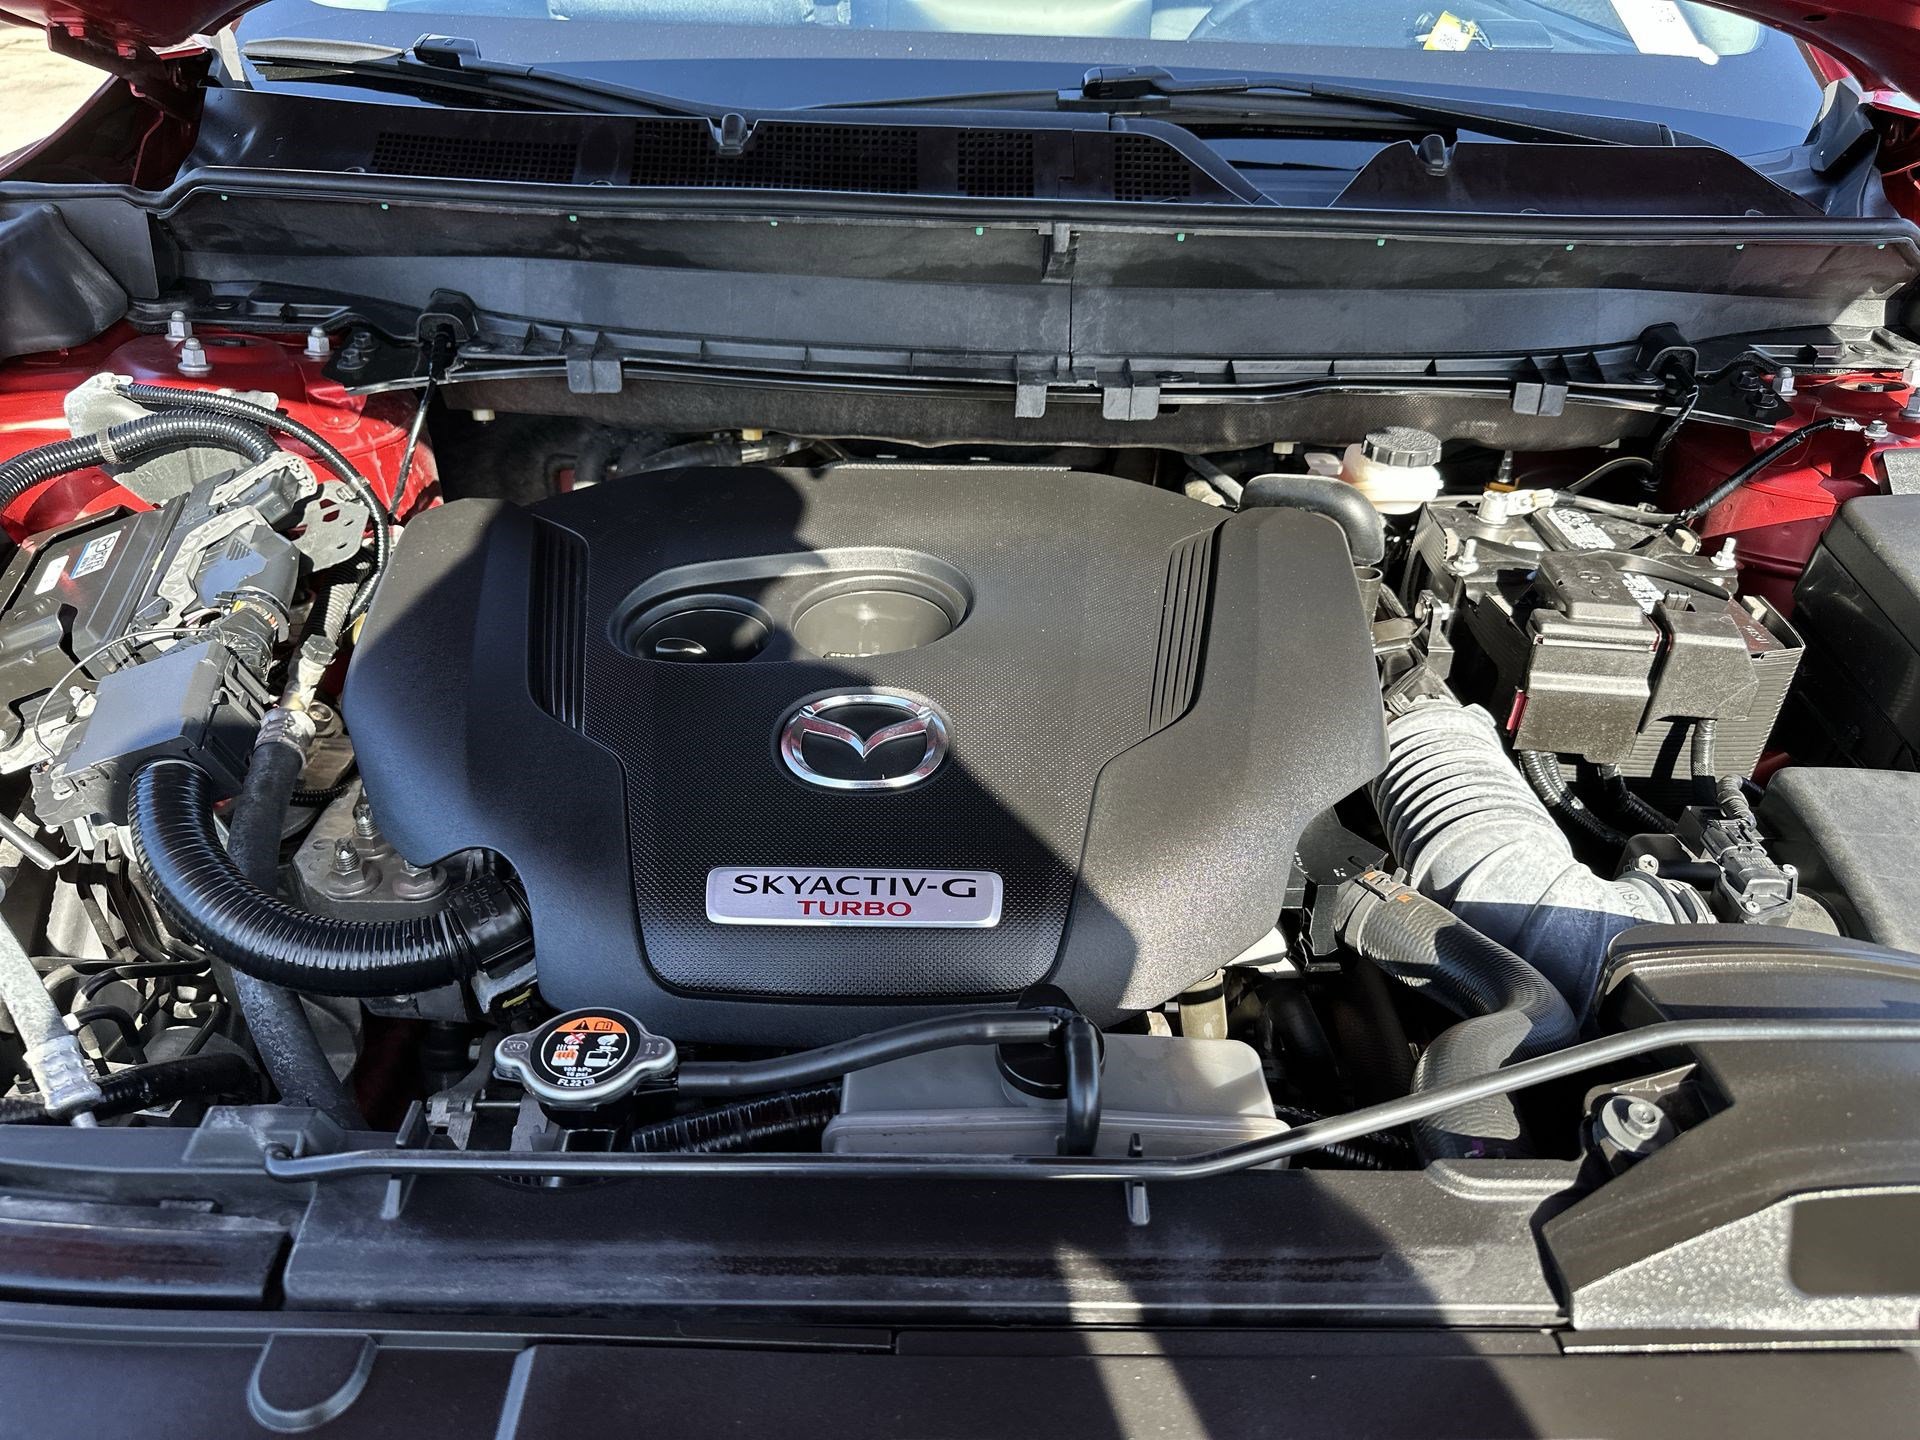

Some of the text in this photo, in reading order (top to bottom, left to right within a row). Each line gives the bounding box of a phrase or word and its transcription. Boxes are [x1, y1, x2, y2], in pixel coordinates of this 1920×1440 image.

[732, 874, 977, 898] SKYACTIV-G
[797, 900, 912, 917] TURBO
[557, 1078, 582, 1087] FL22
